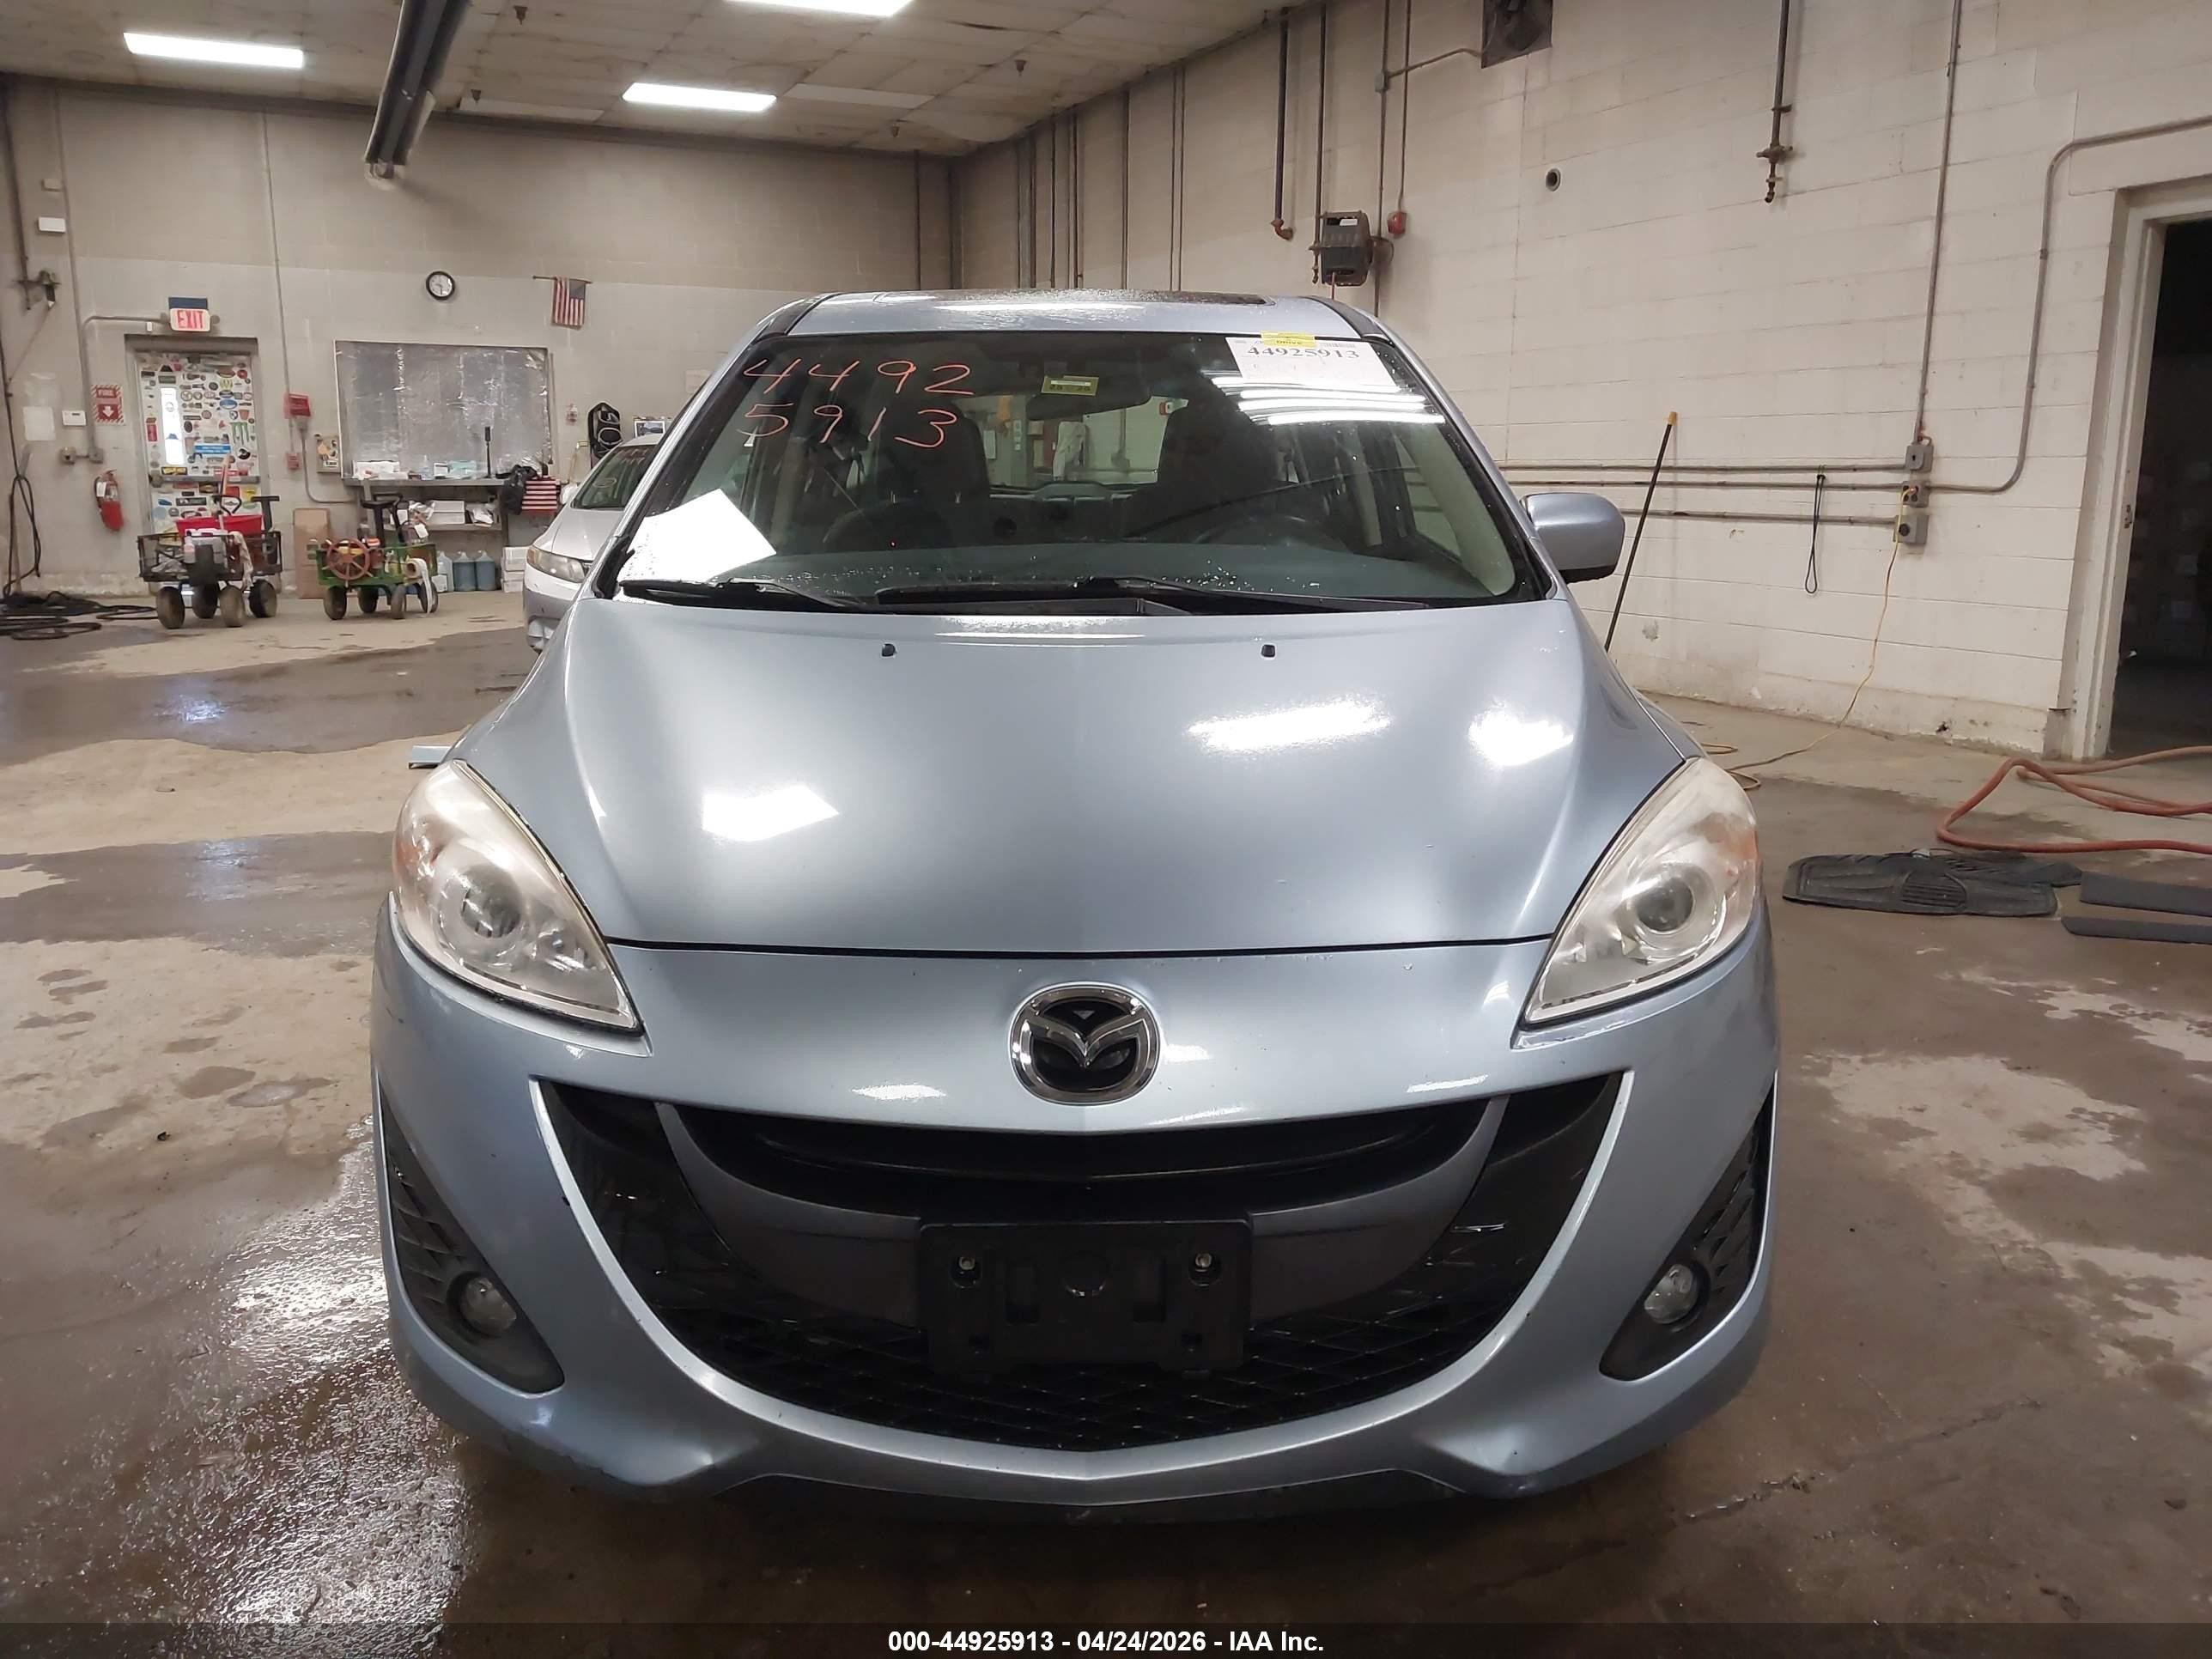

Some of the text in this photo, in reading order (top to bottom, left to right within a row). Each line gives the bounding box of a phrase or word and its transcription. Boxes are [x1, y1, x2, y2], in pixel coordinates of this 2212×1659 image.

[176, 309, 204, 329] EXIT
[1247, 346, 1360, 359] 44925913
[743, 358, 975, 395] 4492
[737, 402, 958, 448] 5913
